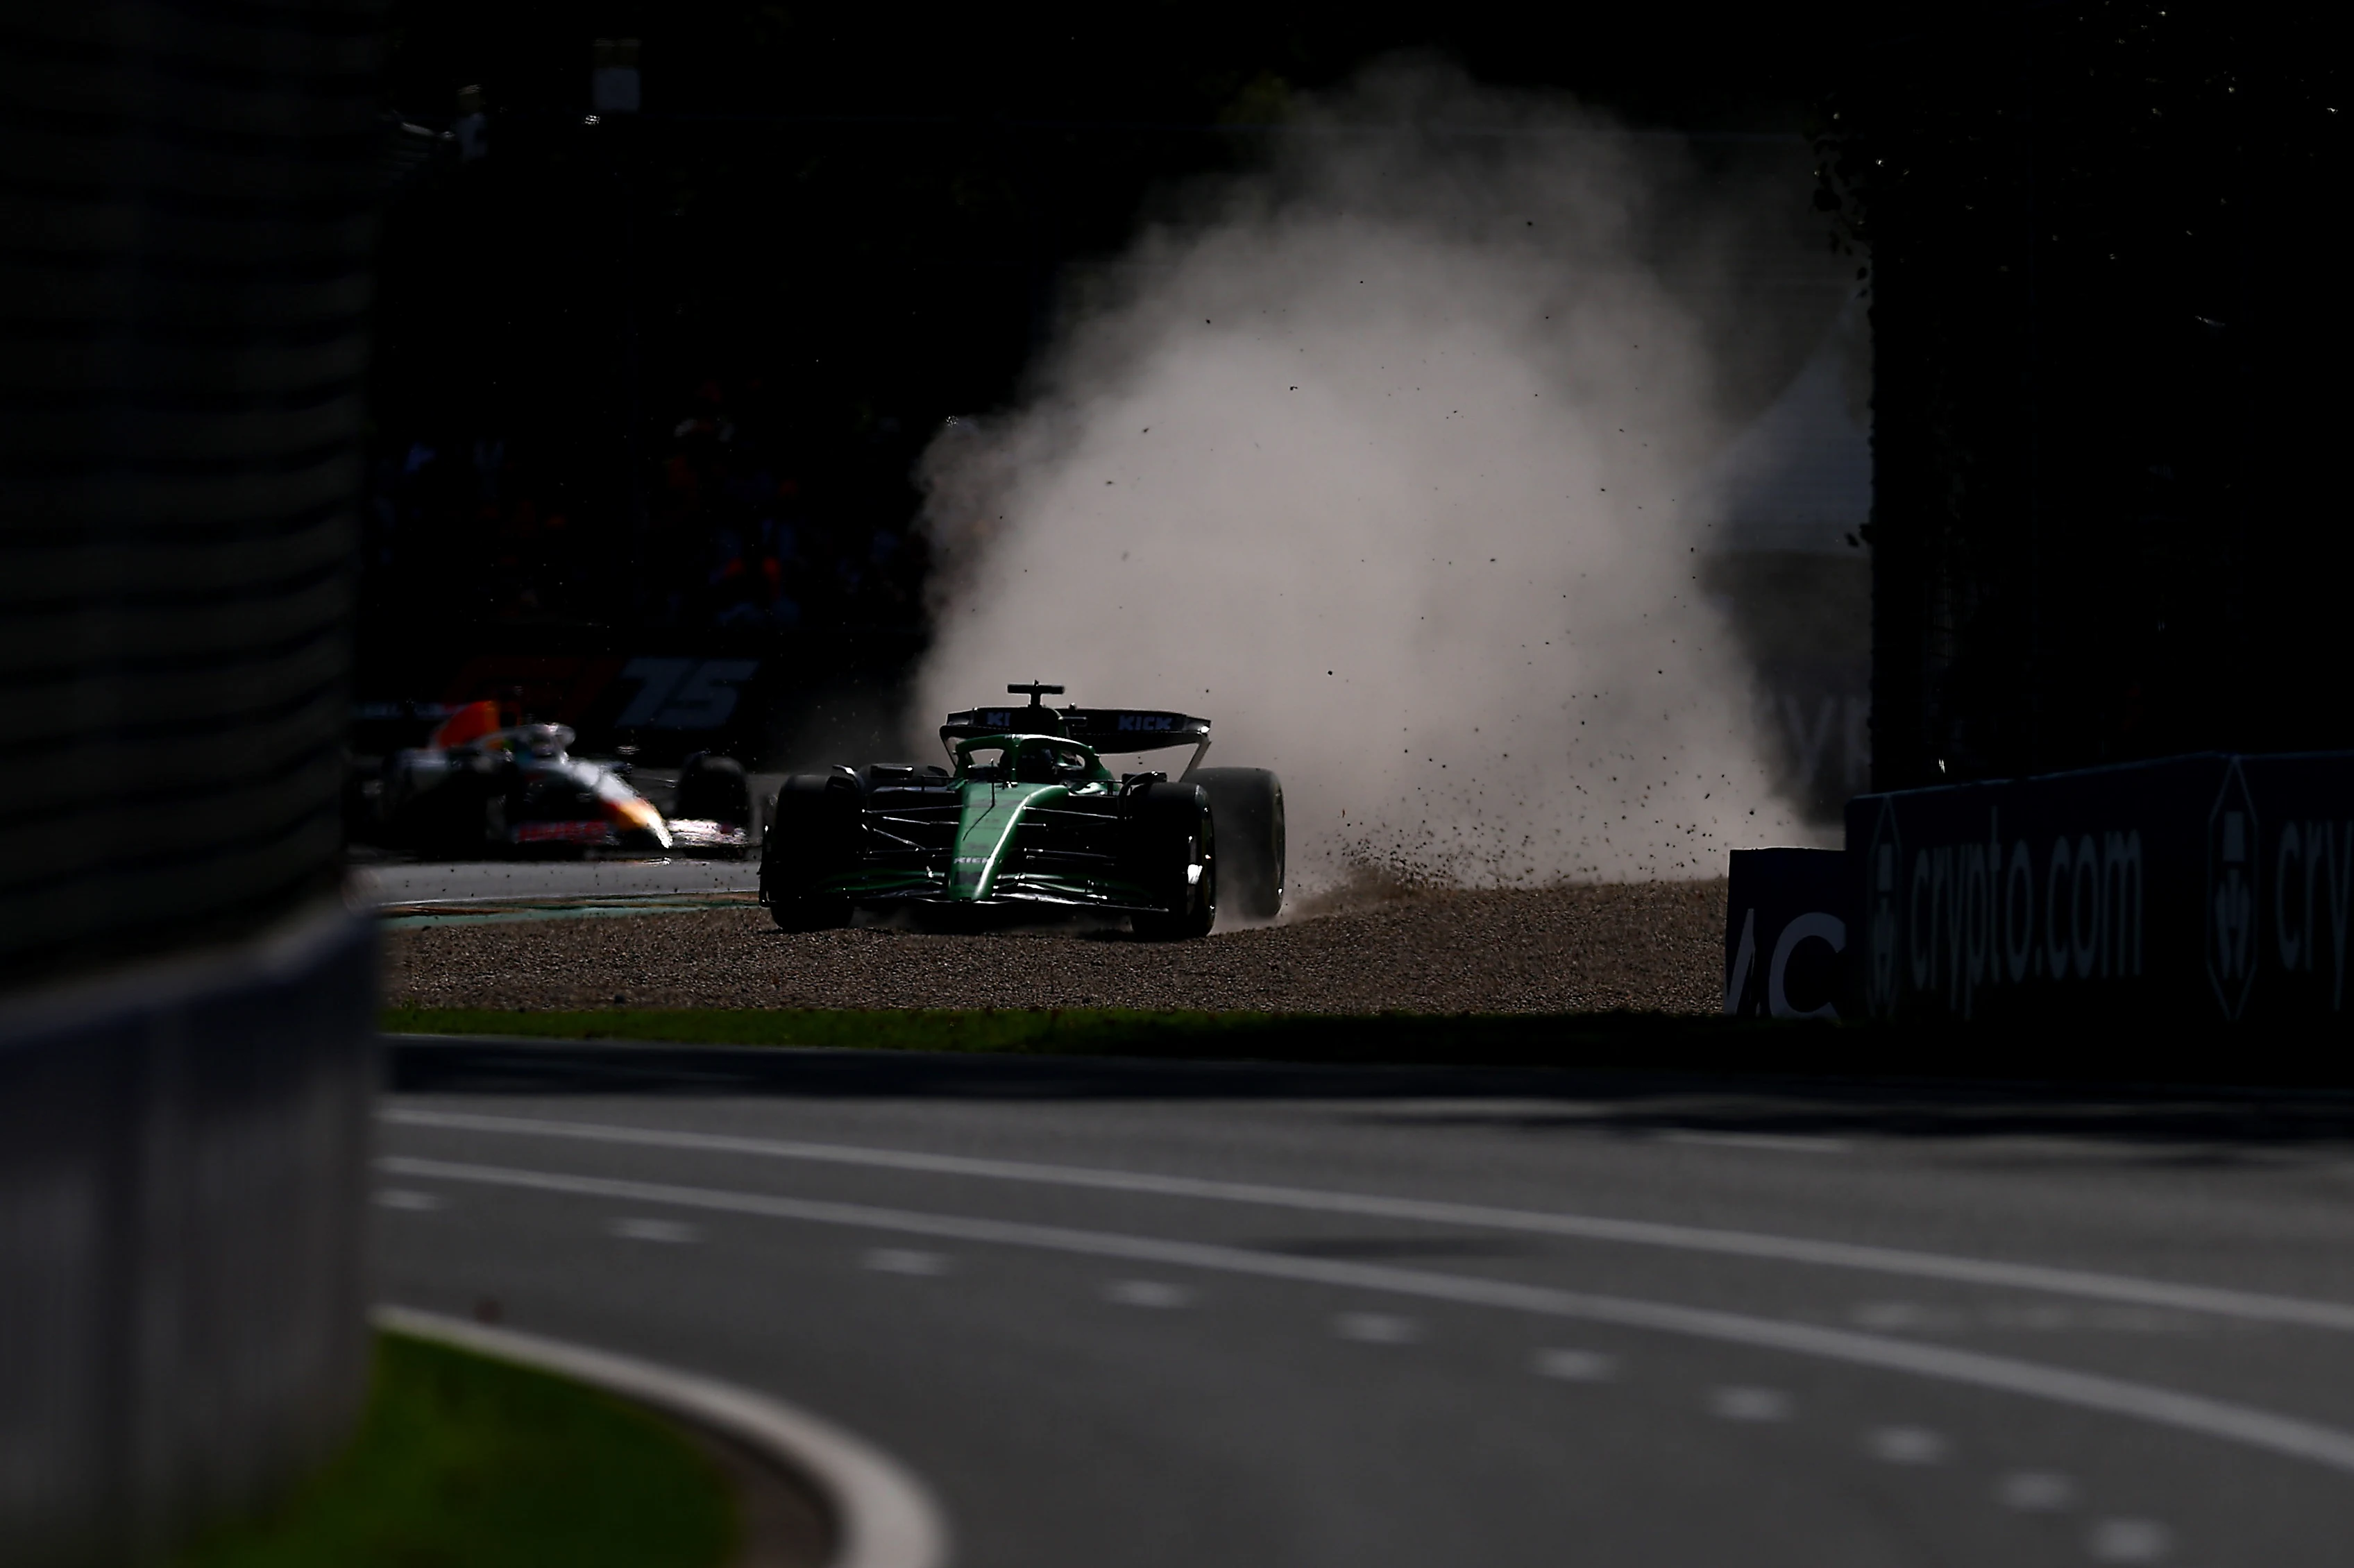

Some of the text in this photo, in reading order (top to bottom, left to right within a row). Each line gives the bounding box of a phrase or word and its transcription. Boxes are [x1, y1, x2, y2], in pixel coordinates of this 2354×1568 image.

[613, 656, 765, 732] 75
[986, 711, 1012, 727] KI
[1117, 714, 1174, 732] KICK
[1911, 805, 2144, 1023] crypto.com
